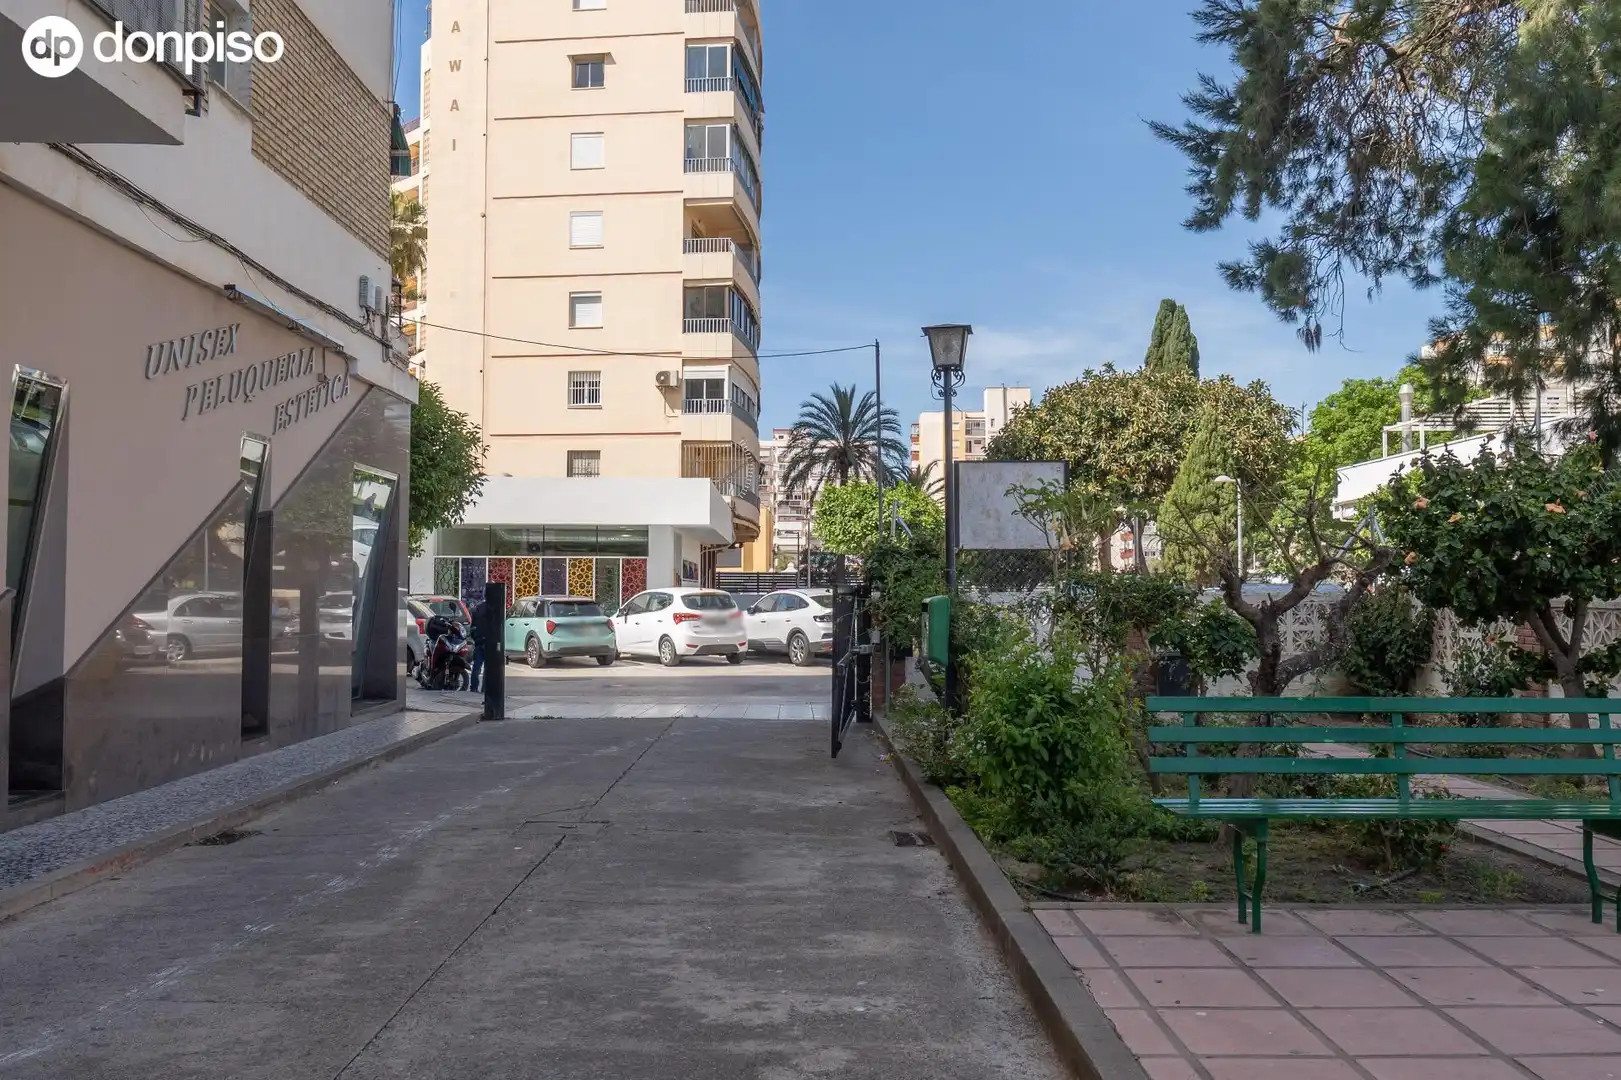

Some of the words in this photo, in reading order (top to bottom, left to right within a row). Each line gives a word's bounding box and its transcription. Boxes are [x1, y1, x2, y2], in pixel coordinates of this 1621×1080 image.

[145, 322, 241, 380] UNISEX
[181, 347, 316, 421] PELUQUERIA
[272, 371, 351, 436] ESTETICA
